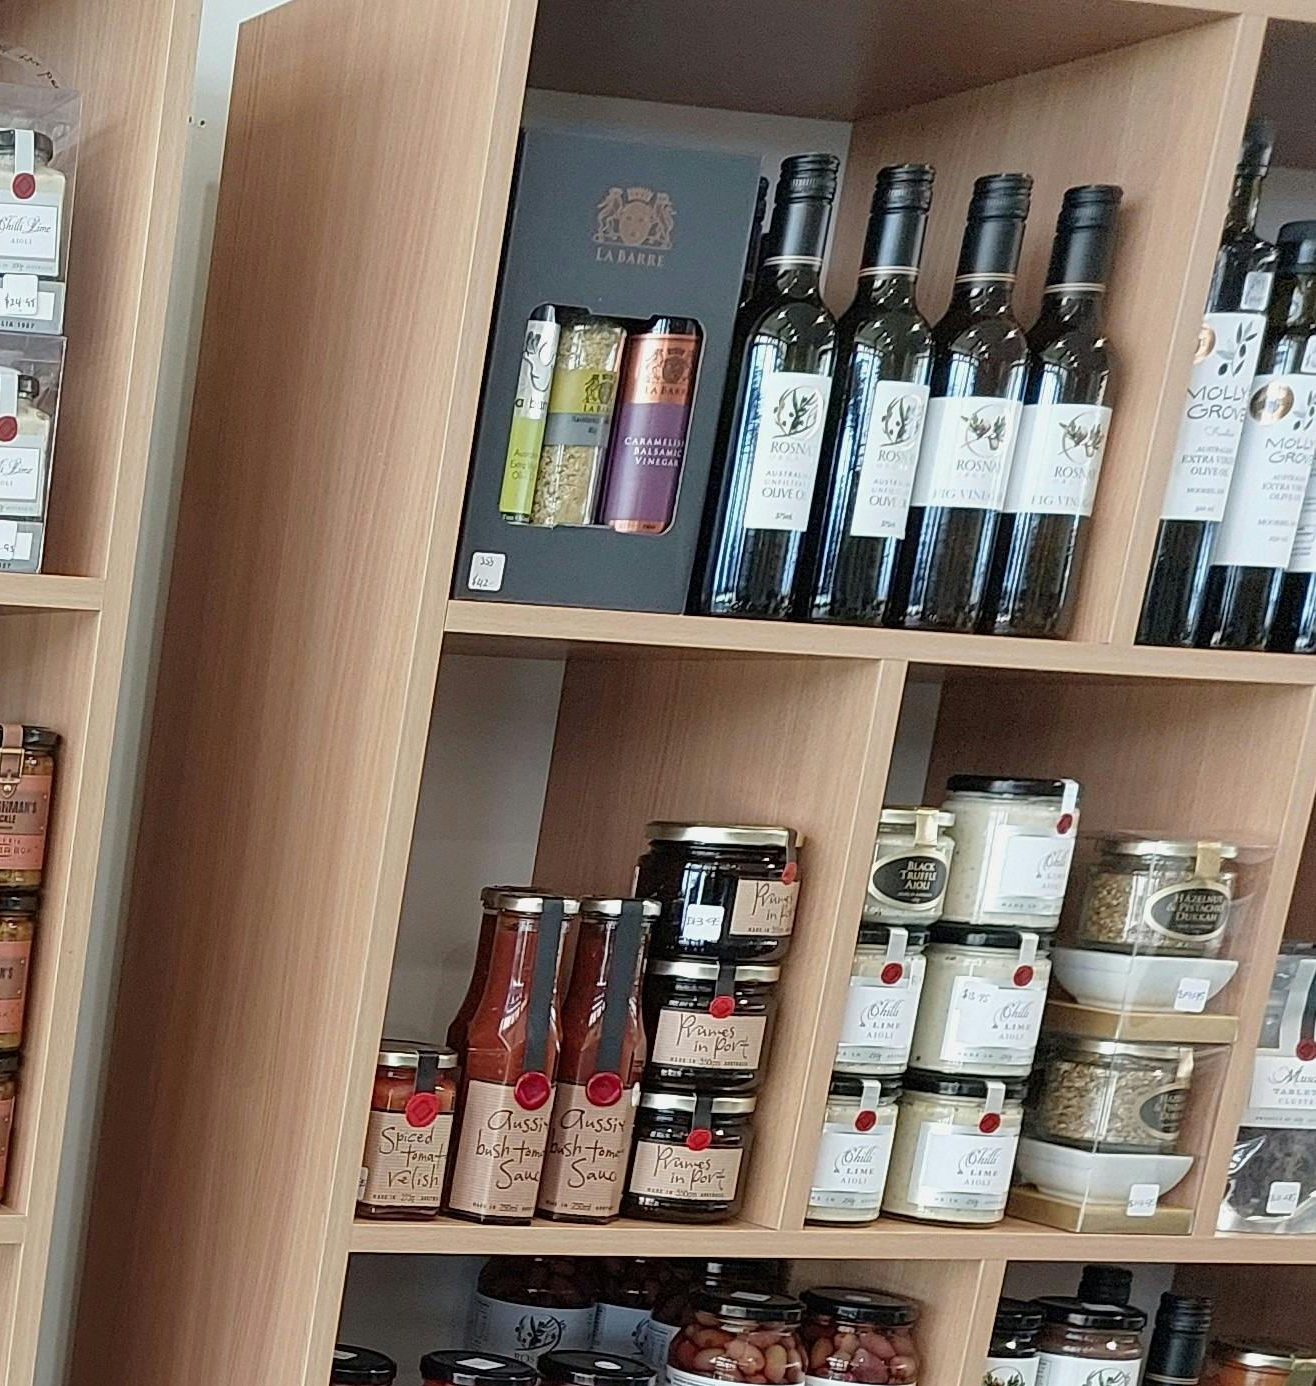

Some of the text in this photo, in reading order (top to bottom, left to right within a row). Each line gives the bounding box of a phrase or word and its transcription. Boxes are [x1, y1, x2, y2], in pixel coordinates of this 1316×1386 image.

[596, 247, 665, 268] LA BARRE
[633, 447, 683, 458] BALSAMIC
[635, 456, 679, 467] VINEGAR
[907, 860, 936, 872] BLACK
[899, 870, 936, 881] TRUFFLE
[904, 880, 930, 890] AIOLI
[678, 1013, 735, 1046] Prunes
[693, 1039, 709, 1053] in
[381, 1127, 434, 1149] Spiced
[387, 1166, 440, 1189] relish
